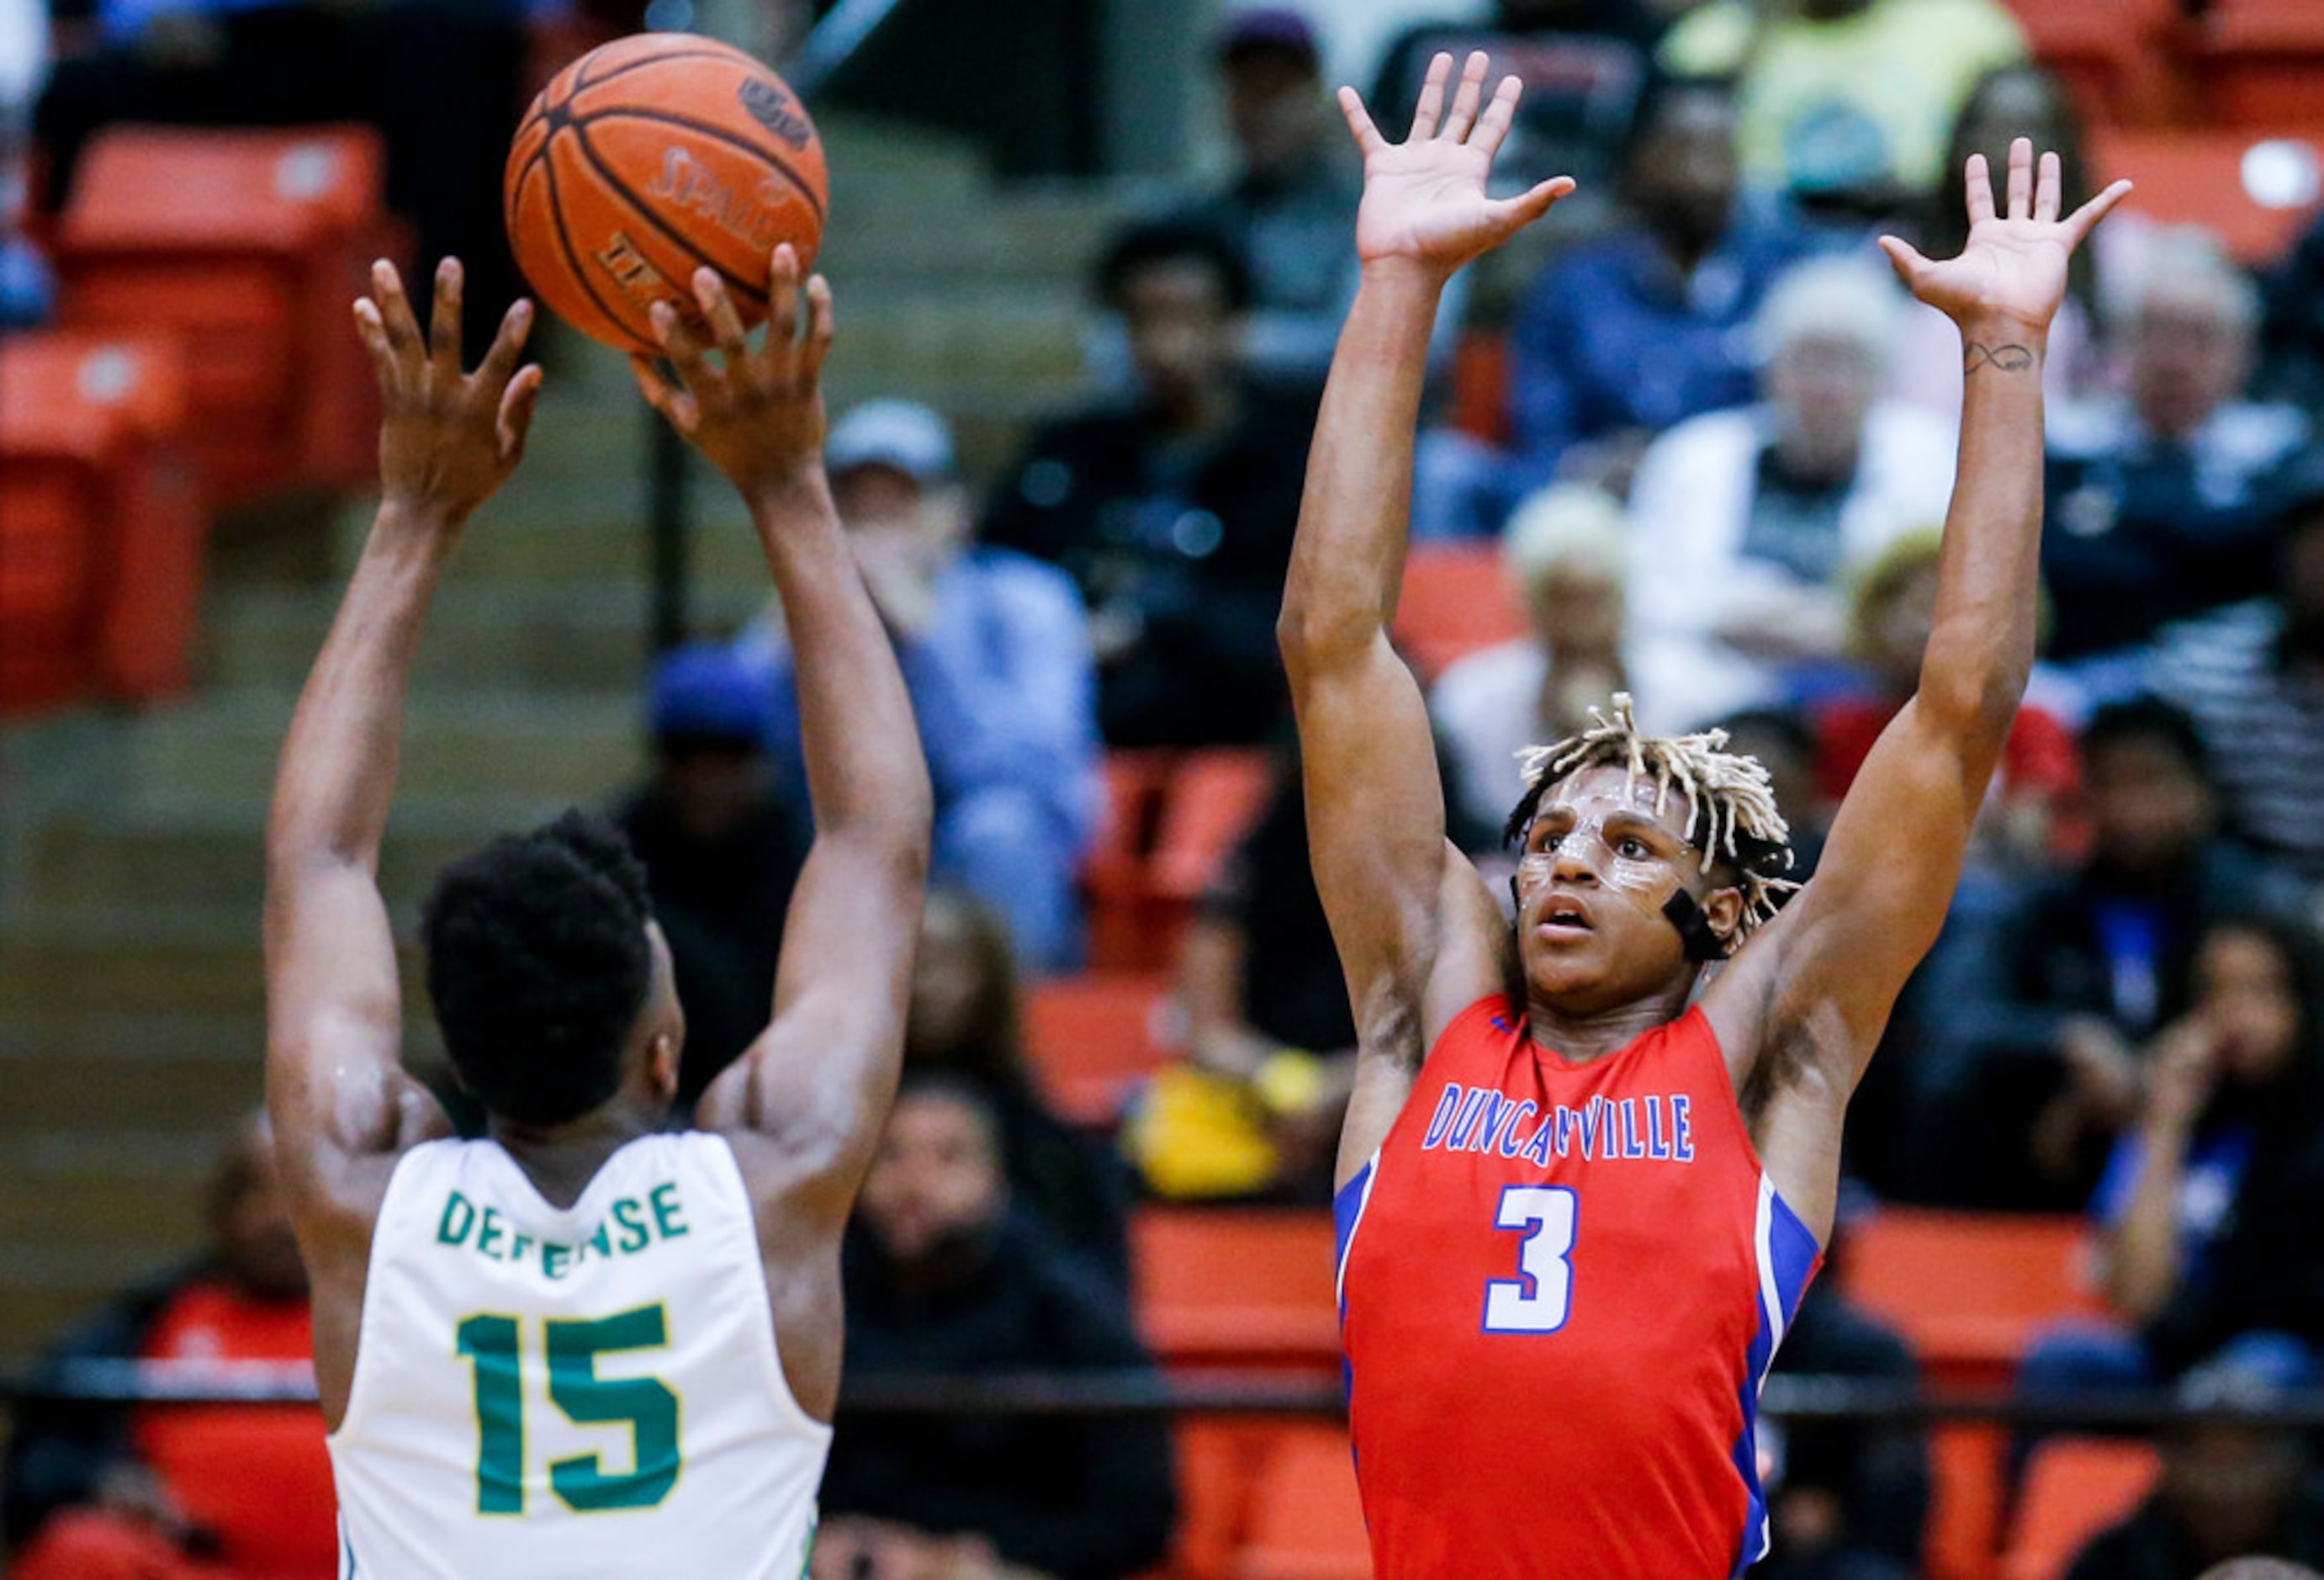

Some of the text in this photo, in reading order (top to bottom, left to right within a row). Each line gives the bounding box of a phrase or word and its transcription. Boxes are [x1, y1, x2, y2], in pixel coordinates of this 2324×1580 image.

[1421, 1083, 1694, 1168] DUNCANVILLE
[437, 1182, 689, 1280] DEFENSE
[1481, 1185, 1580, 1334] 3
[453, 1299, 685, 1518] 15
